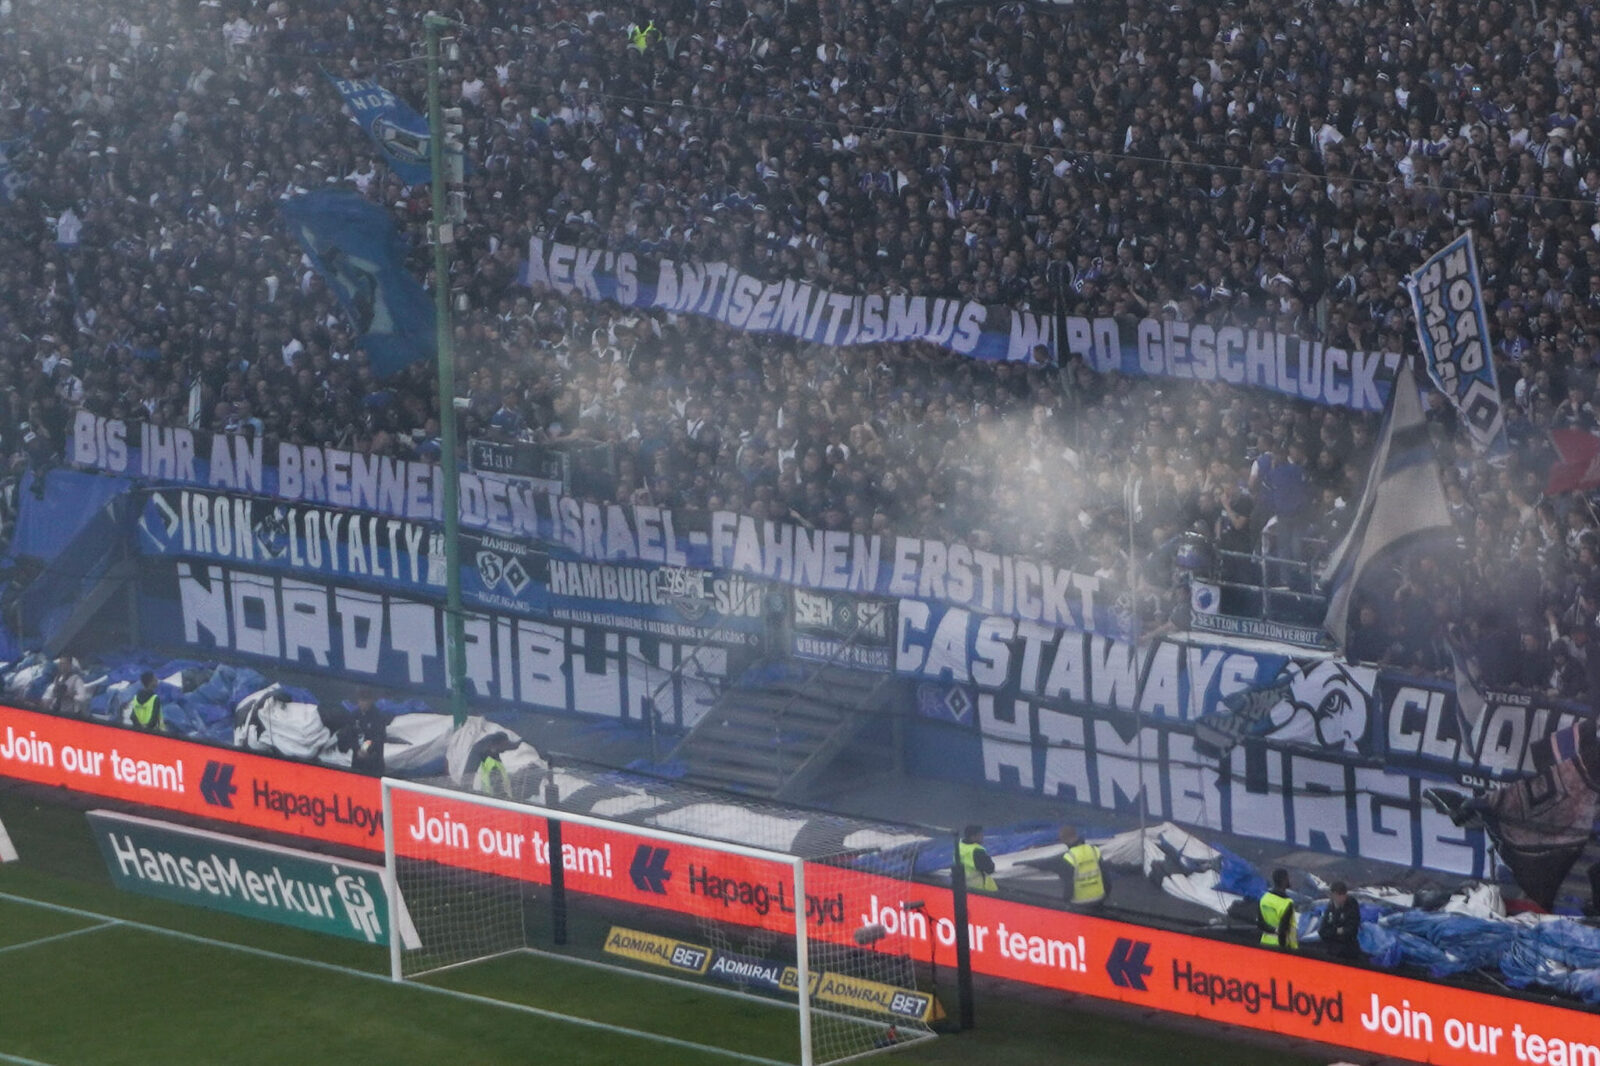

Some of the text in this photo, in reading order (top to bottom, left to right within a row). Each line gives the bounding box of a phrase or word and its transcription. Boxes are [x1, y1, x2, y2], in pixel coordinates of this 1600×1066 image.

[651, 258, 986, 353] ANTISEMITISMUS
[74, 411, 128, 472] BIS
[141, 423, 196, 482] IHR
[209, 433, 263, 492] AN
[891, 536, 1099, 631] ERSTICKT
[181, 490, 424, 582] IRON LOYALTY
[1198, 614, 1238, 632] SEKTION
[897, 599, 1258, 722] CASTAWAYS
[1, 727, 185, 793] Join our team!
[979, 693, 1476, 875] HAMBURGE
[410, 807, 469, 849] Join
[478, 828, 526, 860] our
[109, 832, 335, 919] HanseMerkur
[689, 863, 844, 926] Hapag-Loyd
[608, 933, 705, 969] ADMIRAL BET
[861, 894, 927, 940] Join
[997, 922, 1087, 972] team!
[713, 955, 779, 984] ADMIRAL
[822, 979, 927, 1016] ADMIRAL BET
[1173, 959, 1343, 1026] Hapag-Lloyd
[1361, 993, 1433, 1042] Join
[1443, 1017, 1502, 1057] our
